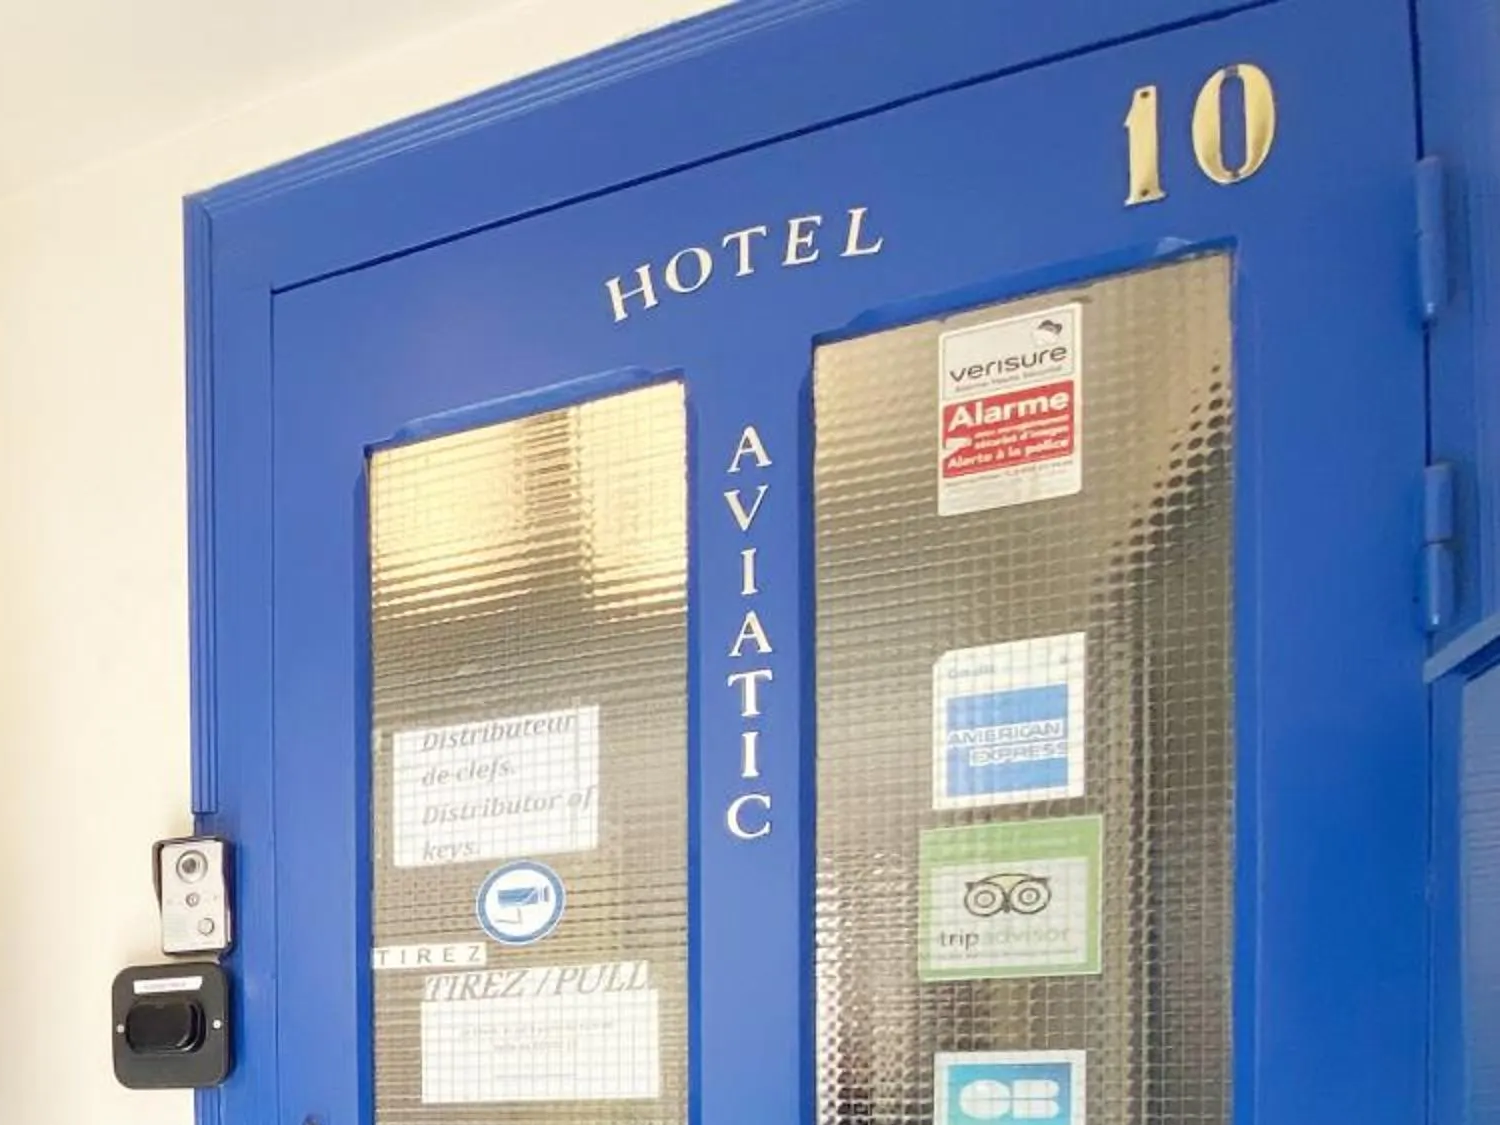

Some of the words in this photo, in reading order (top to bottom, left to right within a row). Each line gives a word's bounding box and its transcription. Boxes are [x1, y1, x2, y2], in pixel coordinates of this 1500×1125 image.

[1124, 63, 1276, 206] 10
[605, 207, 884, 322] HOTEL
[949, 346, 1068, 383] verisure
[947, 391, 1070, 433] Alarme
[947, 452, 994, 470] Alerte
[1008, 444, 1022, 457] la
[1024, 437, 1070, 458] police
[723, 425, 774, 841] AVIATIC
[421, 713, 576, 751] Distributeur
[949, 721, 1061, 746] AMERICAN
[421, 767, 449, 788] de
[421, 792, 562, 826] Distributor
[566, 785, 597, 812] of
[377, 945, 484, 966] TIREZ
[426, 969, 531, 1002] TIREZ
[553, 959, 649, 997] PULL
